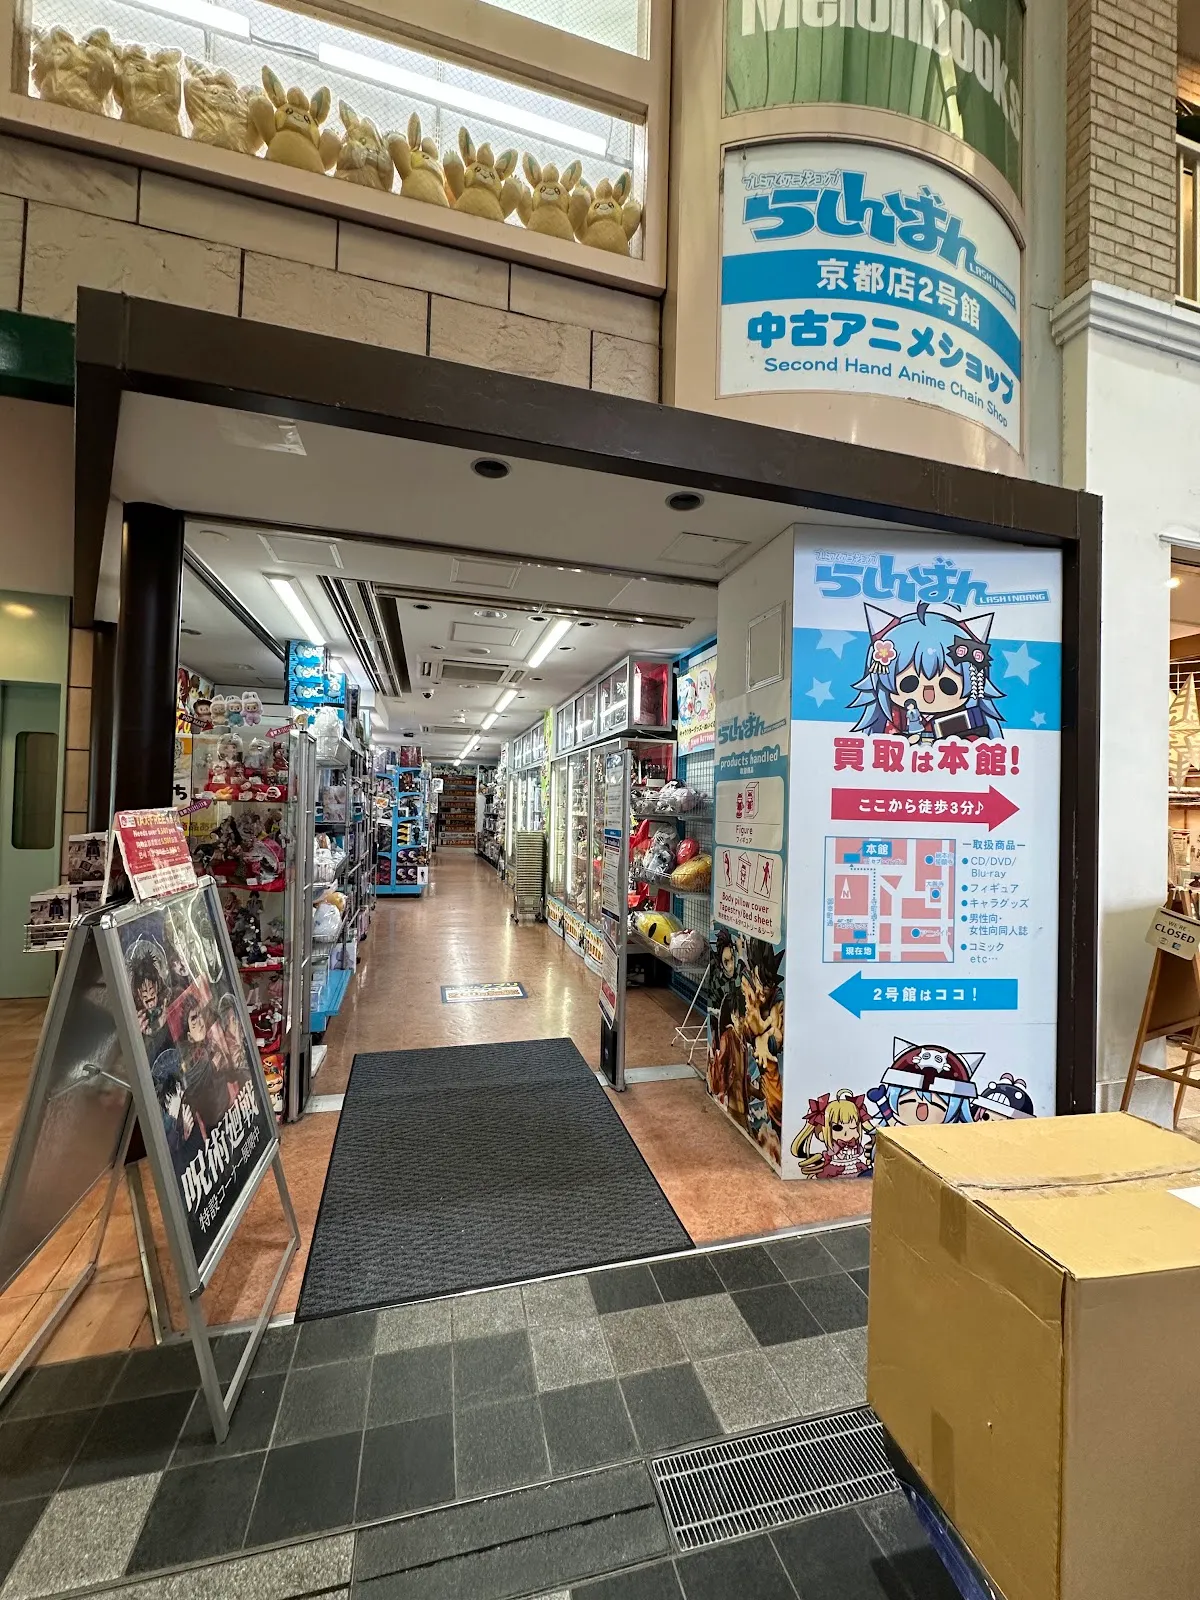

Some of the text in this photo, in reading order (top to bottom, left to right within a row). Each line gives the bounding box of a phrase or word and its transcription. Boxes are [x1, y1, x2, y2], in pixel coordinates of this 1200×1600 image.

[742, 170, 980, 269] らしんばん
[817, 258, 981, 331] 京都店2号館
[747, 309, 1014, 404] 中古アニメショップ
[764, 357, 1008, 428] Second Hand Anime Chain Shop
[814, 555, 989, 606] らしんばん
[980, 593, 1046, 604] LASHINBANG
[718, 712, 765, 744] らしんばん
[720, 755, 748, 771] products
[750, 749, 778, 765] handled
[833, 737, 1020, 776] 買取は本館!
[736, 825, 753, 836] Figure
[866, 844, 889, 855] 本館
[971, 857, 1016, 866] CD/DVD/
[972, 869, 1006, 878] Blu-ray
[970, 883, 1018, 893] フィギュア
[722, 891, 769, 914] Body pillow cover
[970, 898, 1029, 908] キャラグッズ
[754, 913, 773, 928] sheet
[969, 925, 1028, 936] 女性向同人誌
[1155, 923, 1195, 943] CLOSED
[845, 946, 872, 956] 現在地
[970, 942, 1004, 952] コミック
[873, 987, 977, 1002] 2号館はココ！
[181, 1079, 259, 1213] 呪術廻戦
